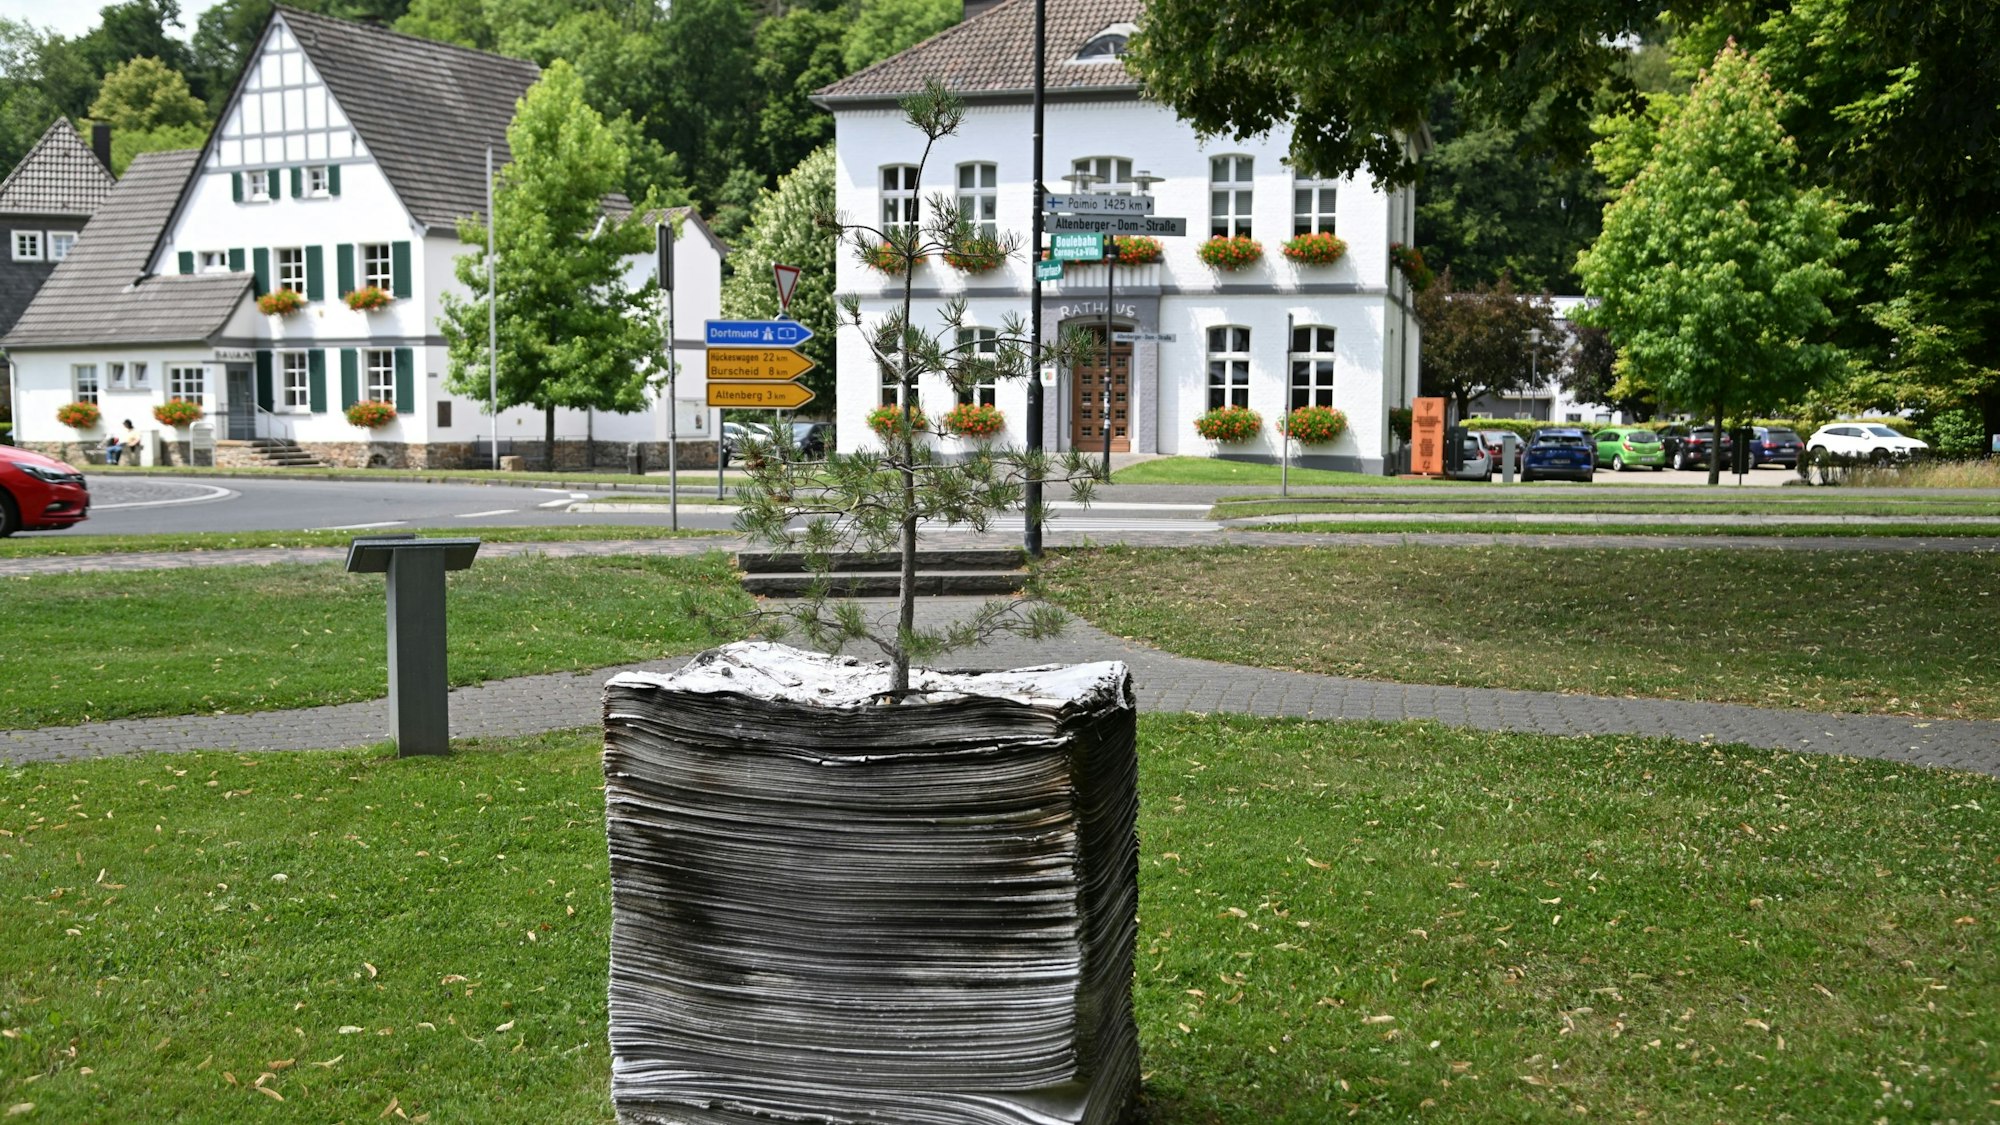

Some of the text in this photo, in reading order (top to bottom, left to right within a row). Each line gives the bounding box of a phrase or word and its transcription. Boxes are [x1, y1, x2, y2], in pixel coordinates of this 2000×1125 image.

[1068, 197, 1143, 211] Paimio 1425 km
[1056, 235, 1097, 248] Boulebahn
[710, 327, 759, 339] Dortmund
[710, 352, 788, 364] Hückeswagen 22 km
[711, 366, 788, 376] Burscheid 8 km
[715, 390, 786, 402] Altenberg 3 km
